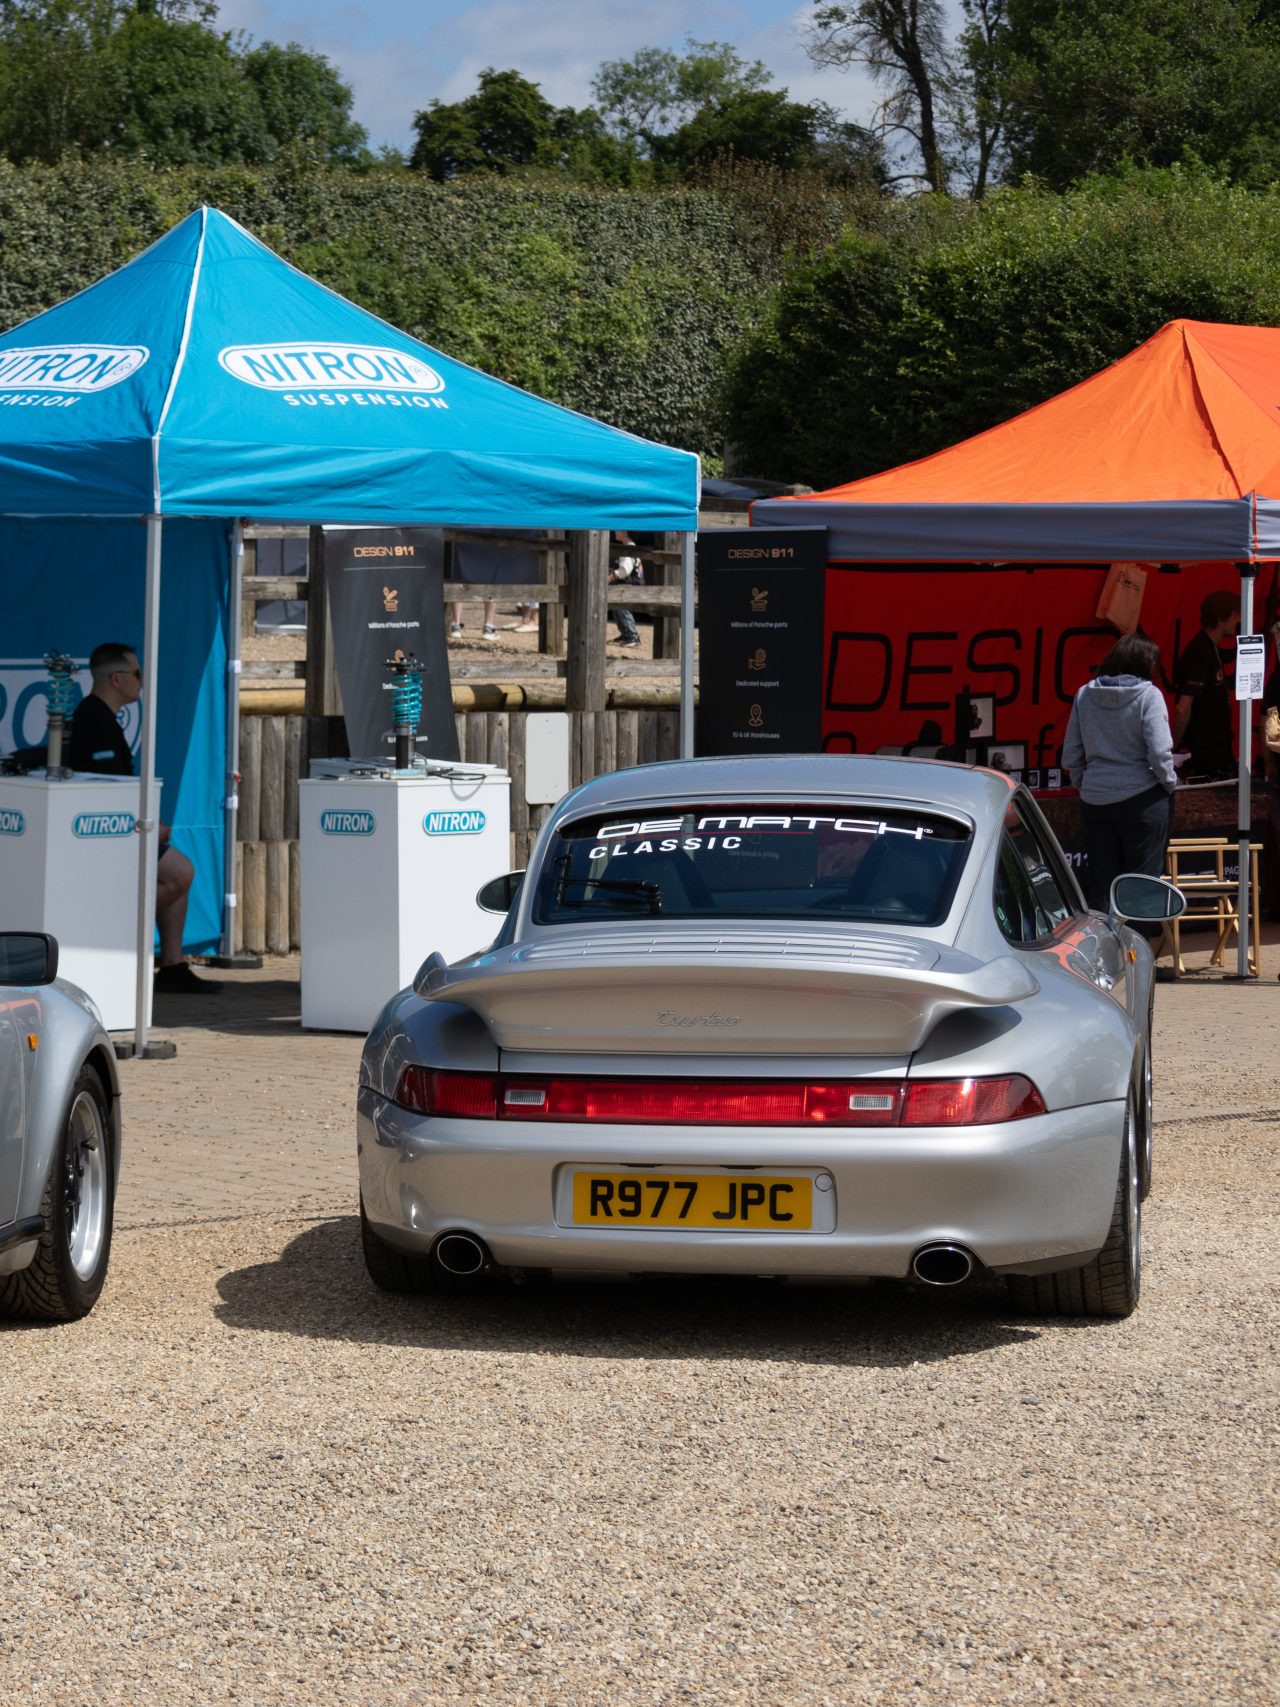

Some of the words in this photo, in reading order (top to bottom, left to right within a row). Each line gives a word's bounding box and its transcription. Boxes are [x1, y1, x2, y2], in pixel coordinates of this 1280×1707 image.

[283, 393, 449, 410] SUSPENSION
[353, 547, 394, 558] DESIGN
[394, 546, 415, 556] 911
[727, 548, 770, 559] DESIGN
[771, 547, 795, 558] 911
[588, 836, 742, 860] CLASSIC
[589, 1179, 698, 1219] R977
[712, 1182, 794, 1222] JPC
